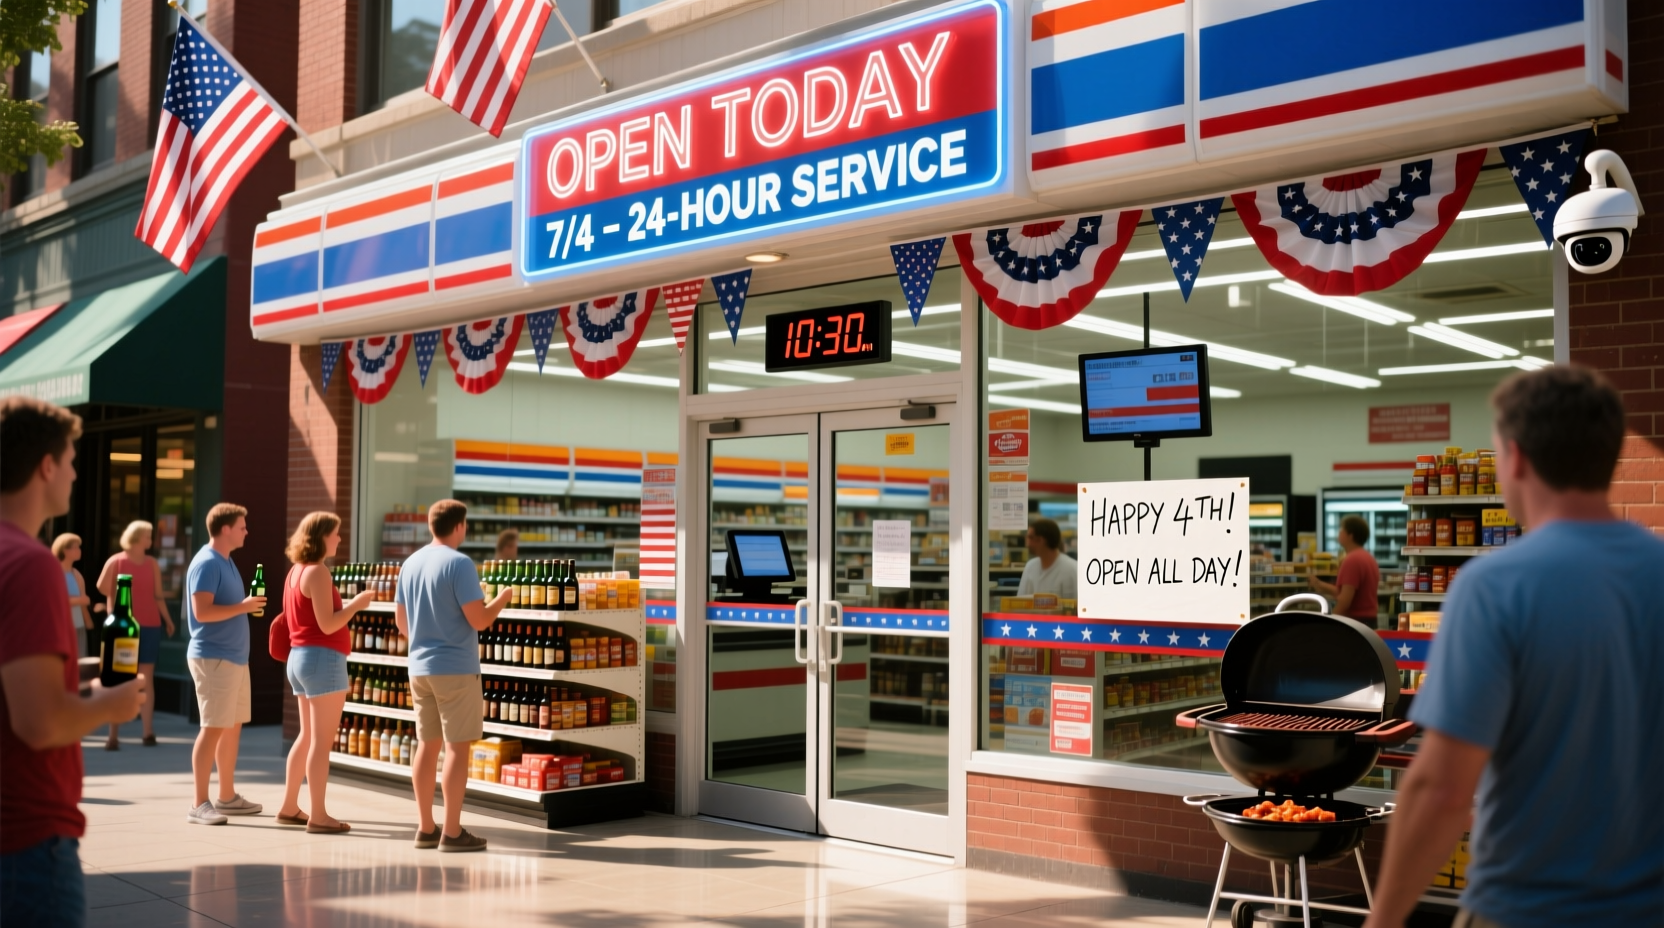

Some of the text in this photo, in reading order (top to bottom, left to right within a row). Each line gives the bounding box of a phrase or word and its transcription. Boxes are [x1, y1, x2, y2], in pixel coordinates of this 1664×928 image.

[546, 31, 951, 199] OPEN TODAY
[546, 214, 594, 260] 7/4
[627, 173, 781, 242] 24-HOUR
[791, 129, 967, 207] SERVICE
[786, 313, 865, 358] 10:30
[1090, 492, 1235, 537] HAPPY 4TH!
[1086, 549, 1243, 588] OPEN ALL DAY!
